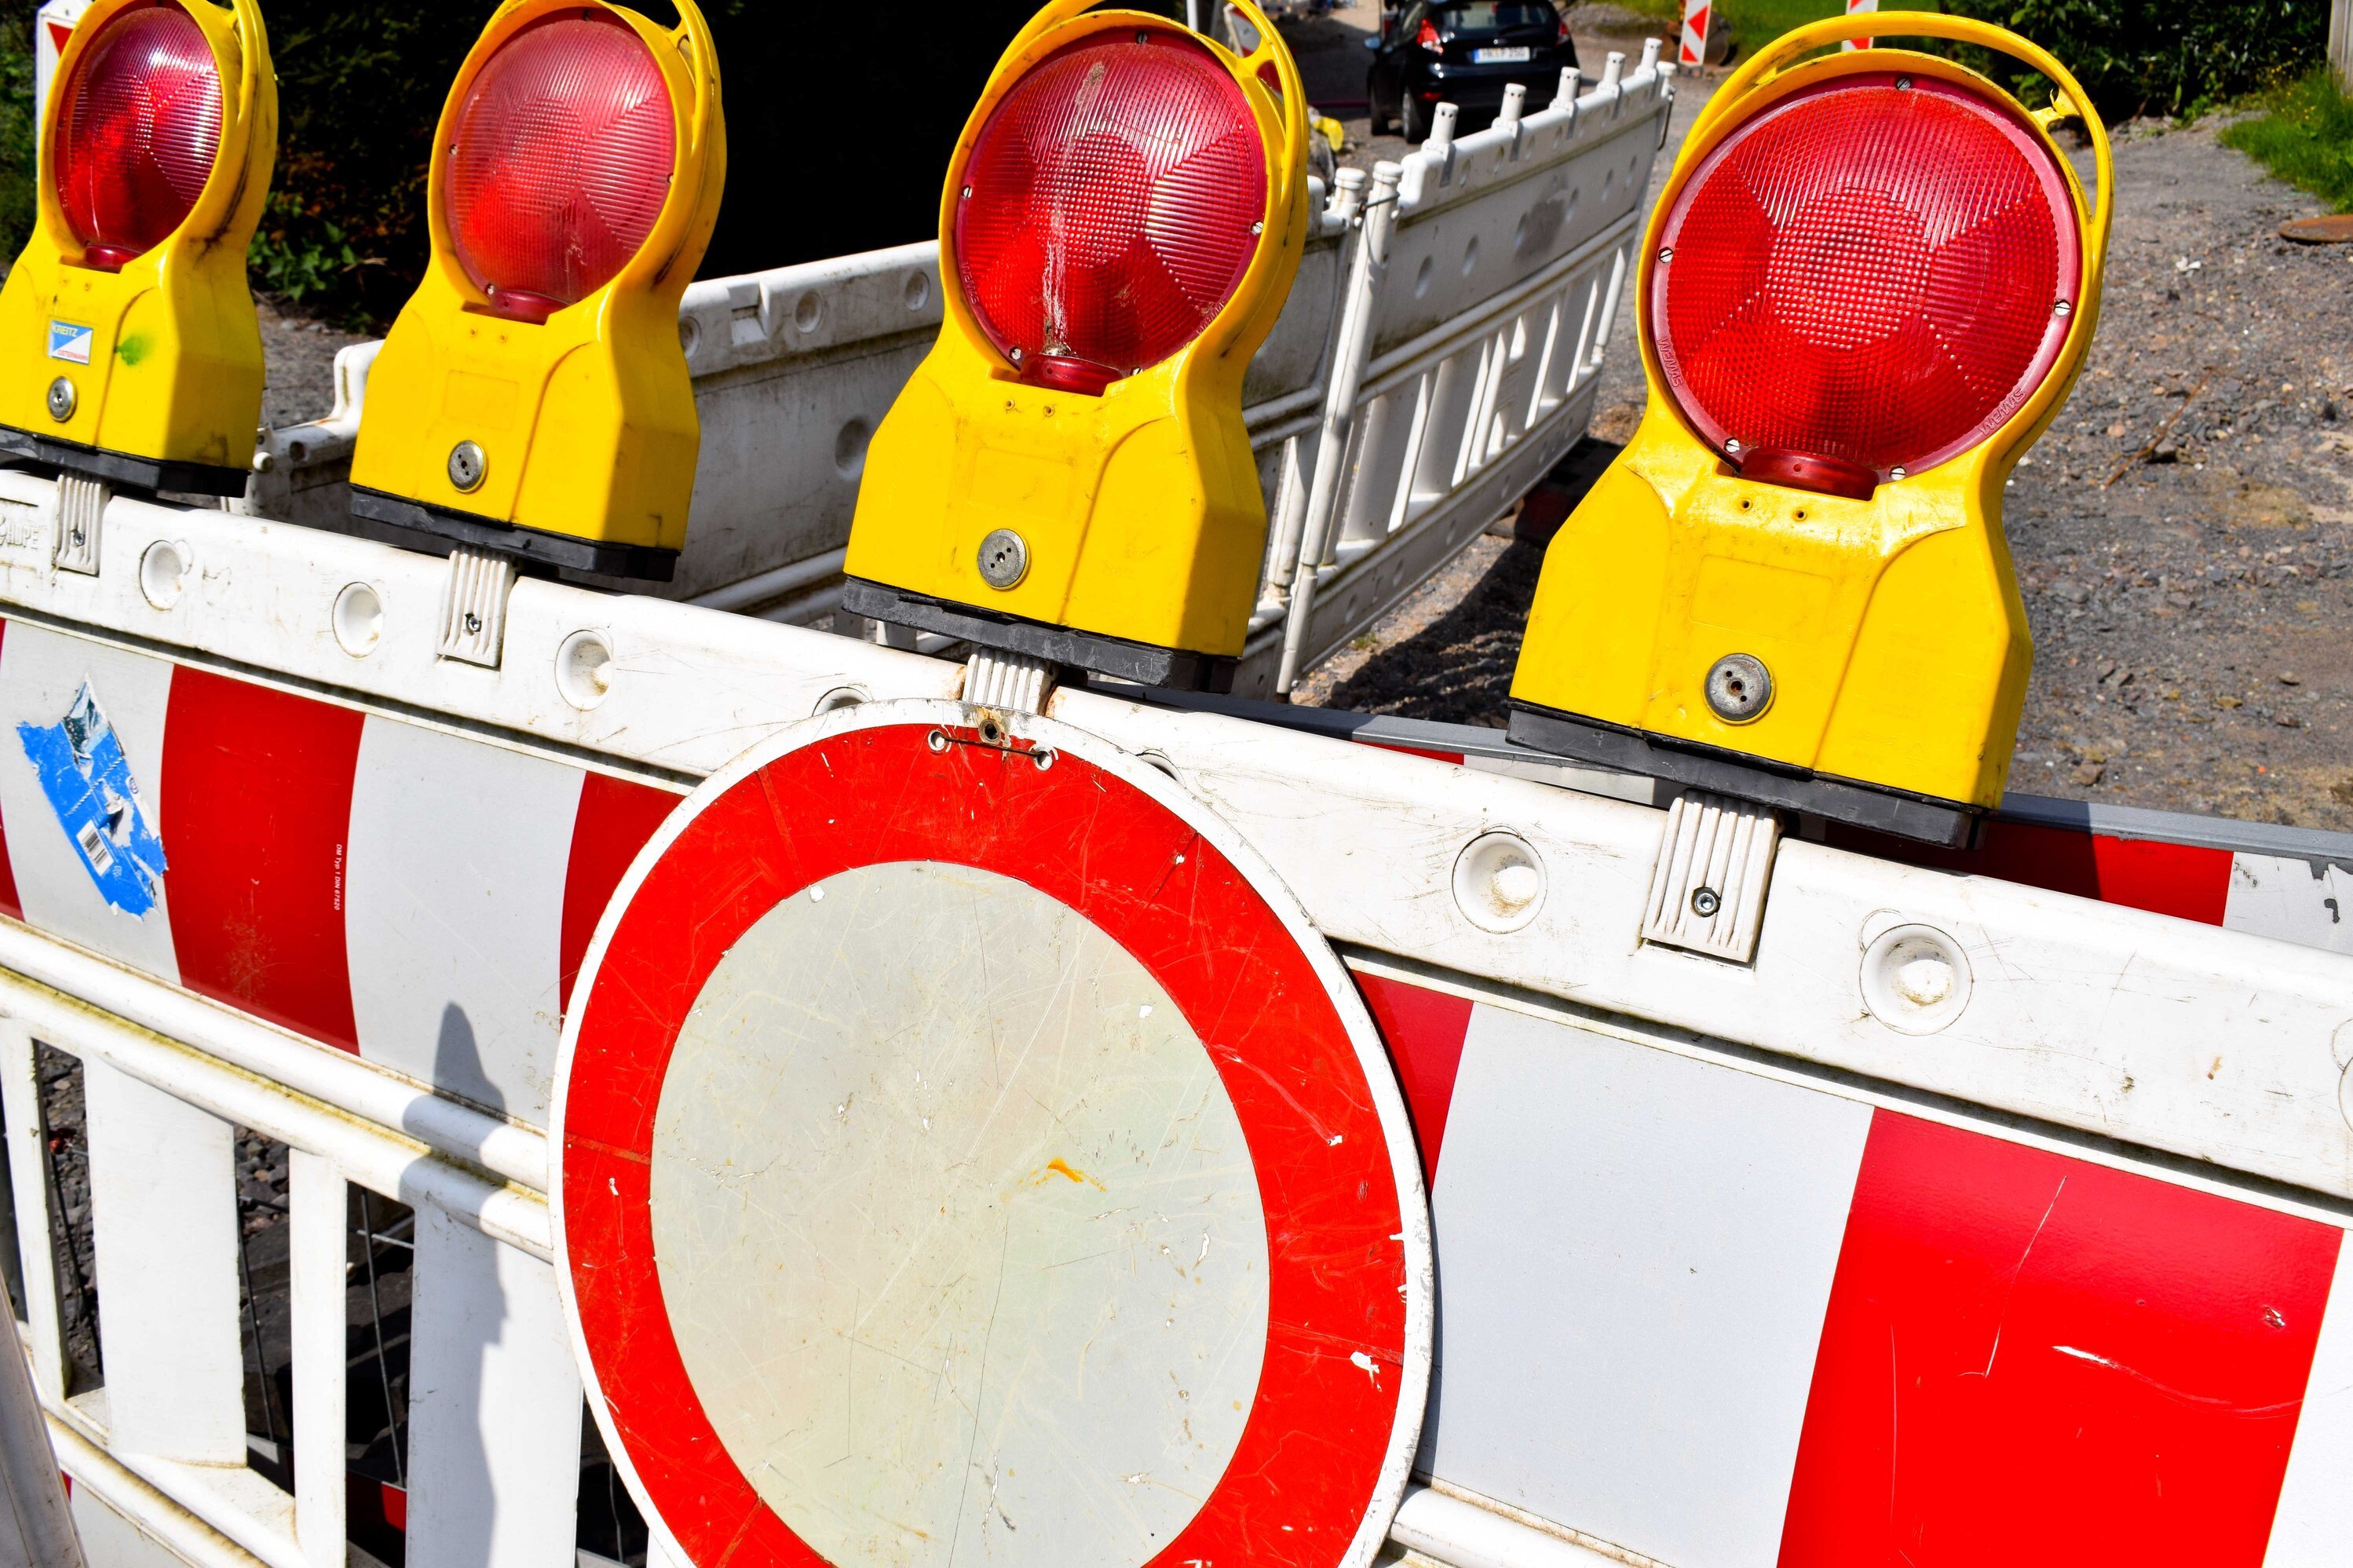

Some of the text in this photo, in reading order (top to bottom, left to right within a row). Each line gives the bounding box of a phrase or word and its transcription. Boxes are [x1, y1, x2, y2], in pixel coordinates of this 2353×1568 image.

[1657, 336, 1683, 387] WEMAS
[1978, 388, 2026, 436] WEMAS
[336, 844, 342, 856] DM
